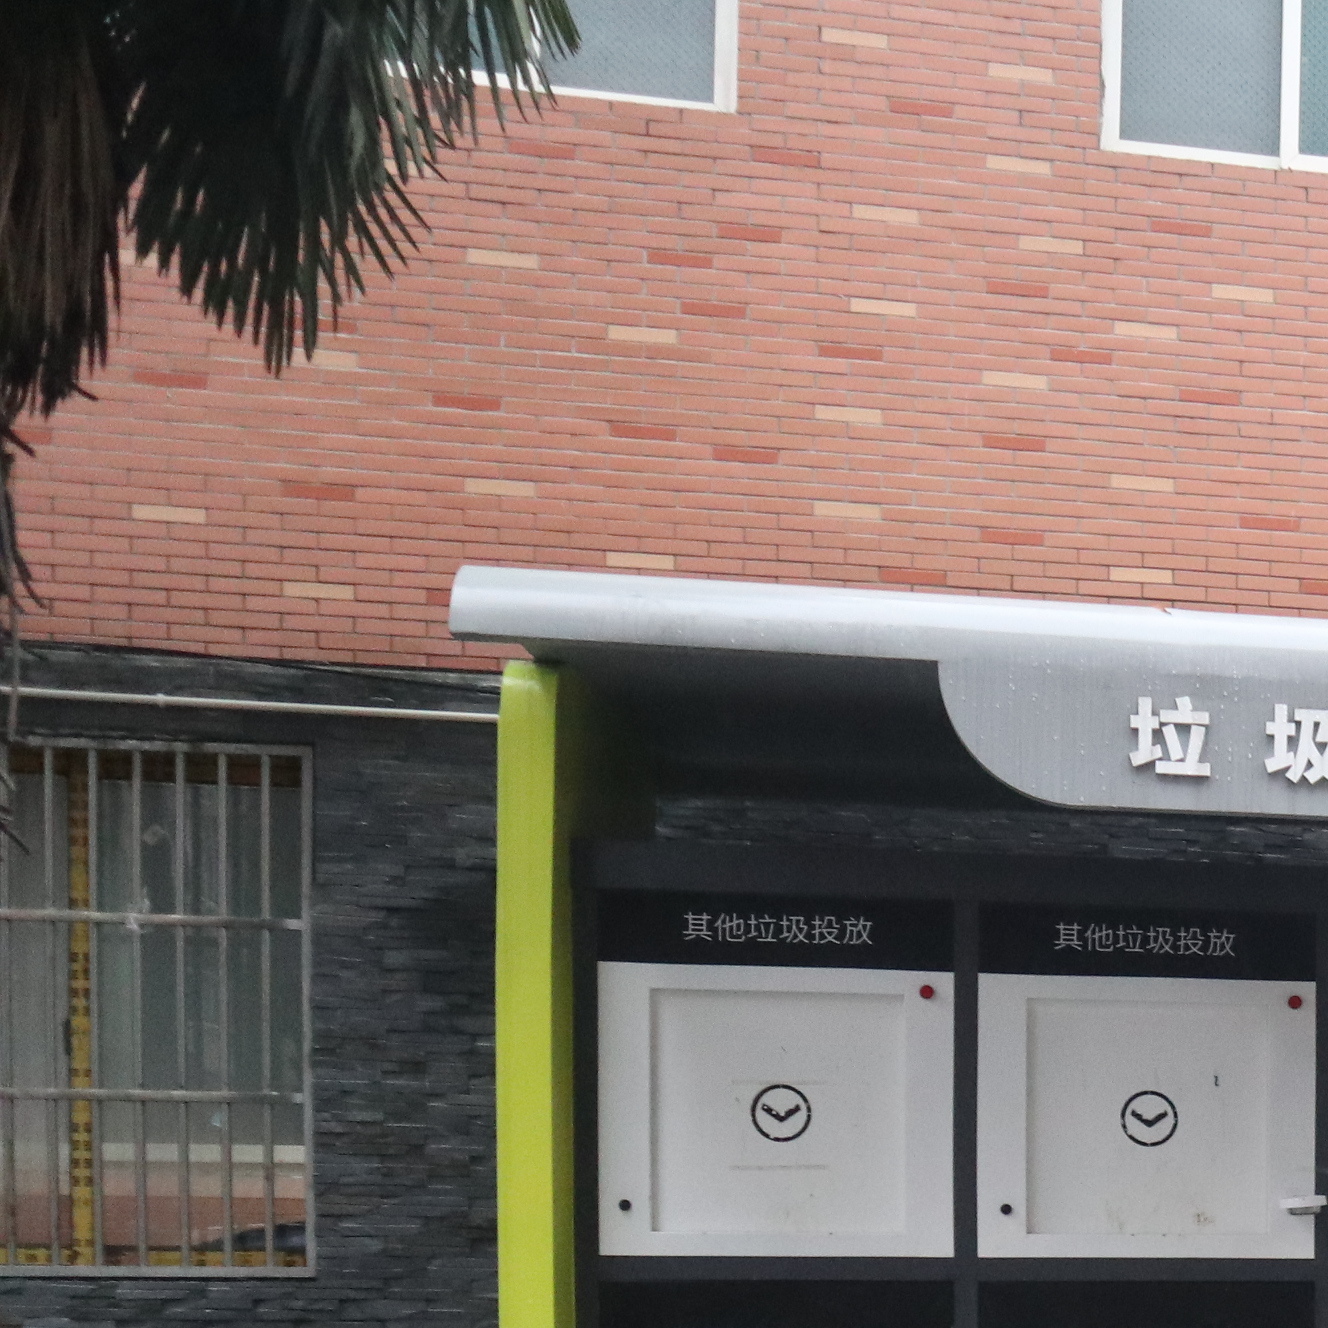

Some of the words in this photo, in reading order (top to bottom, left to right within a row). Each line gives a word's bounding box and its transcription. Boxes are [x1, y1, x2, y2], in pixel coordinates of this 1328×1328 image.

[682, 911, 873, 945] 其他垃圾投放
[1053, 921, 1236, 957] 其他垃圾投放
